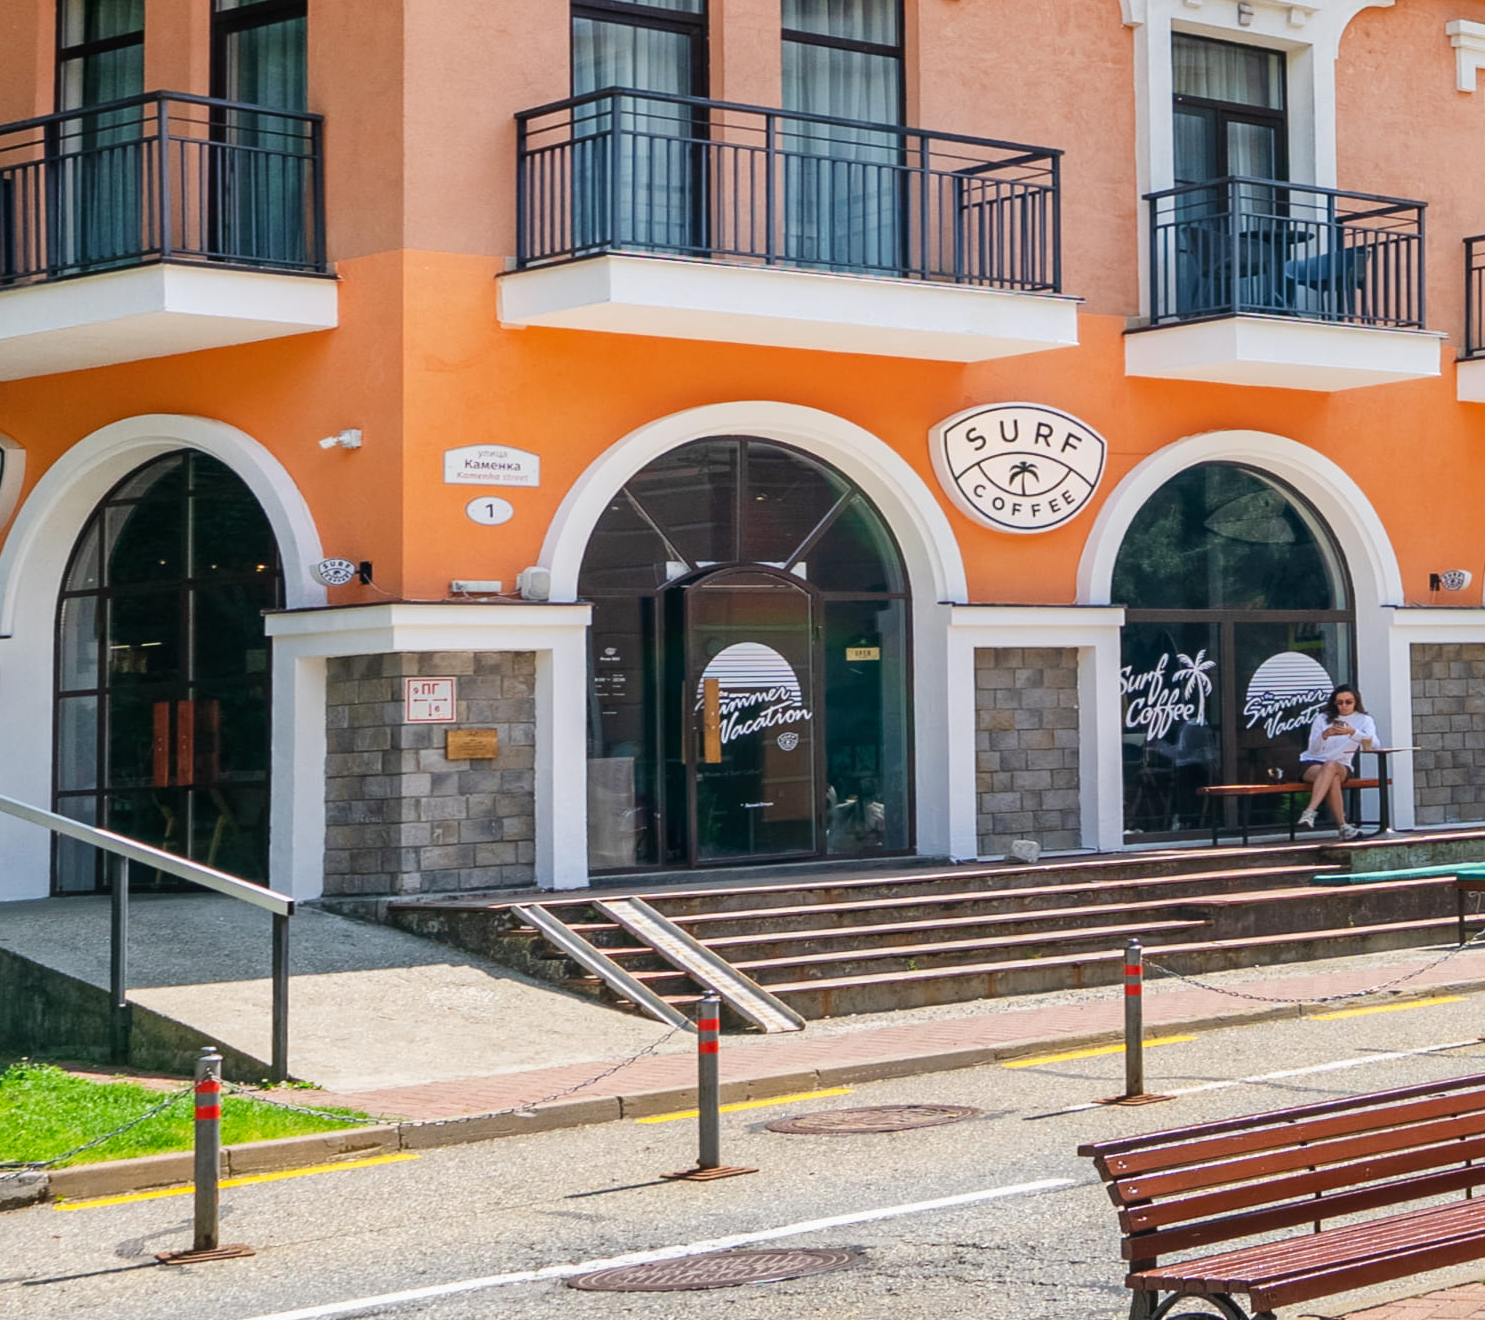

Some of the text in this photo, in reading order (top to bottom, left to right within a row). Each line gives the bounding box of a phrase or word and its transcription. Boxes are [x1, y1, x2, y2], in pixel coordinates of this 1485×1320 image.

[965, 419, 1083, 453] SURF
[464, 459, 521, 471] Каменка
[485, 503, 494, 518] 1
[973, 484, 1076, 518] COFFEE
[1119, 653, 1170, 706] Surf
[695, 686, 791, 715] ummer
[1125, 688, 1195, 741] Coffee
[1243, 689, 1327, 729] Summer
[719, 700, 813, 744] Vacation
[1264, 701, 1328, 739] Vacati
